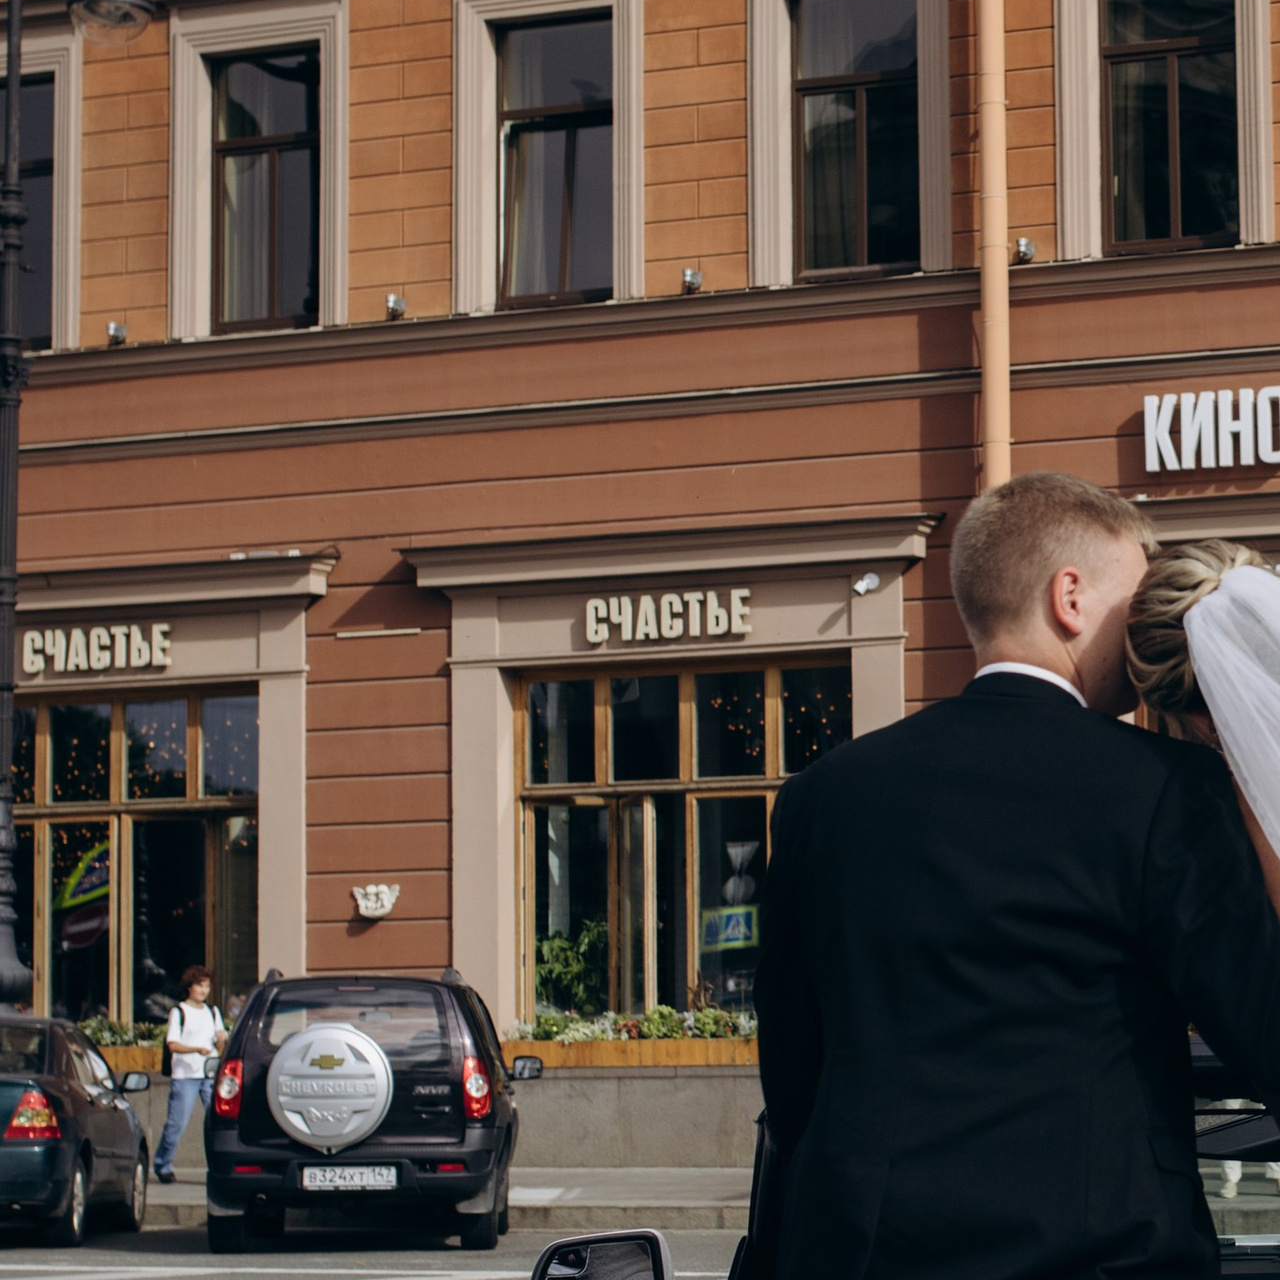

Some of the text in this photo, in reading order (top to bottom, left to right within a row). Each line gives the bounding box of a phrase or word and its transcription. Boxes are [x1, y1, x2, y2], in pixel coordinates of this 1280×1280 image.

[586, 588, 752, 644] СЧАСТЬЕ
[22, 623, 172, 674] СЧАСТЬЕ
[280, 1080, 377, 1095] CHEVROLET
